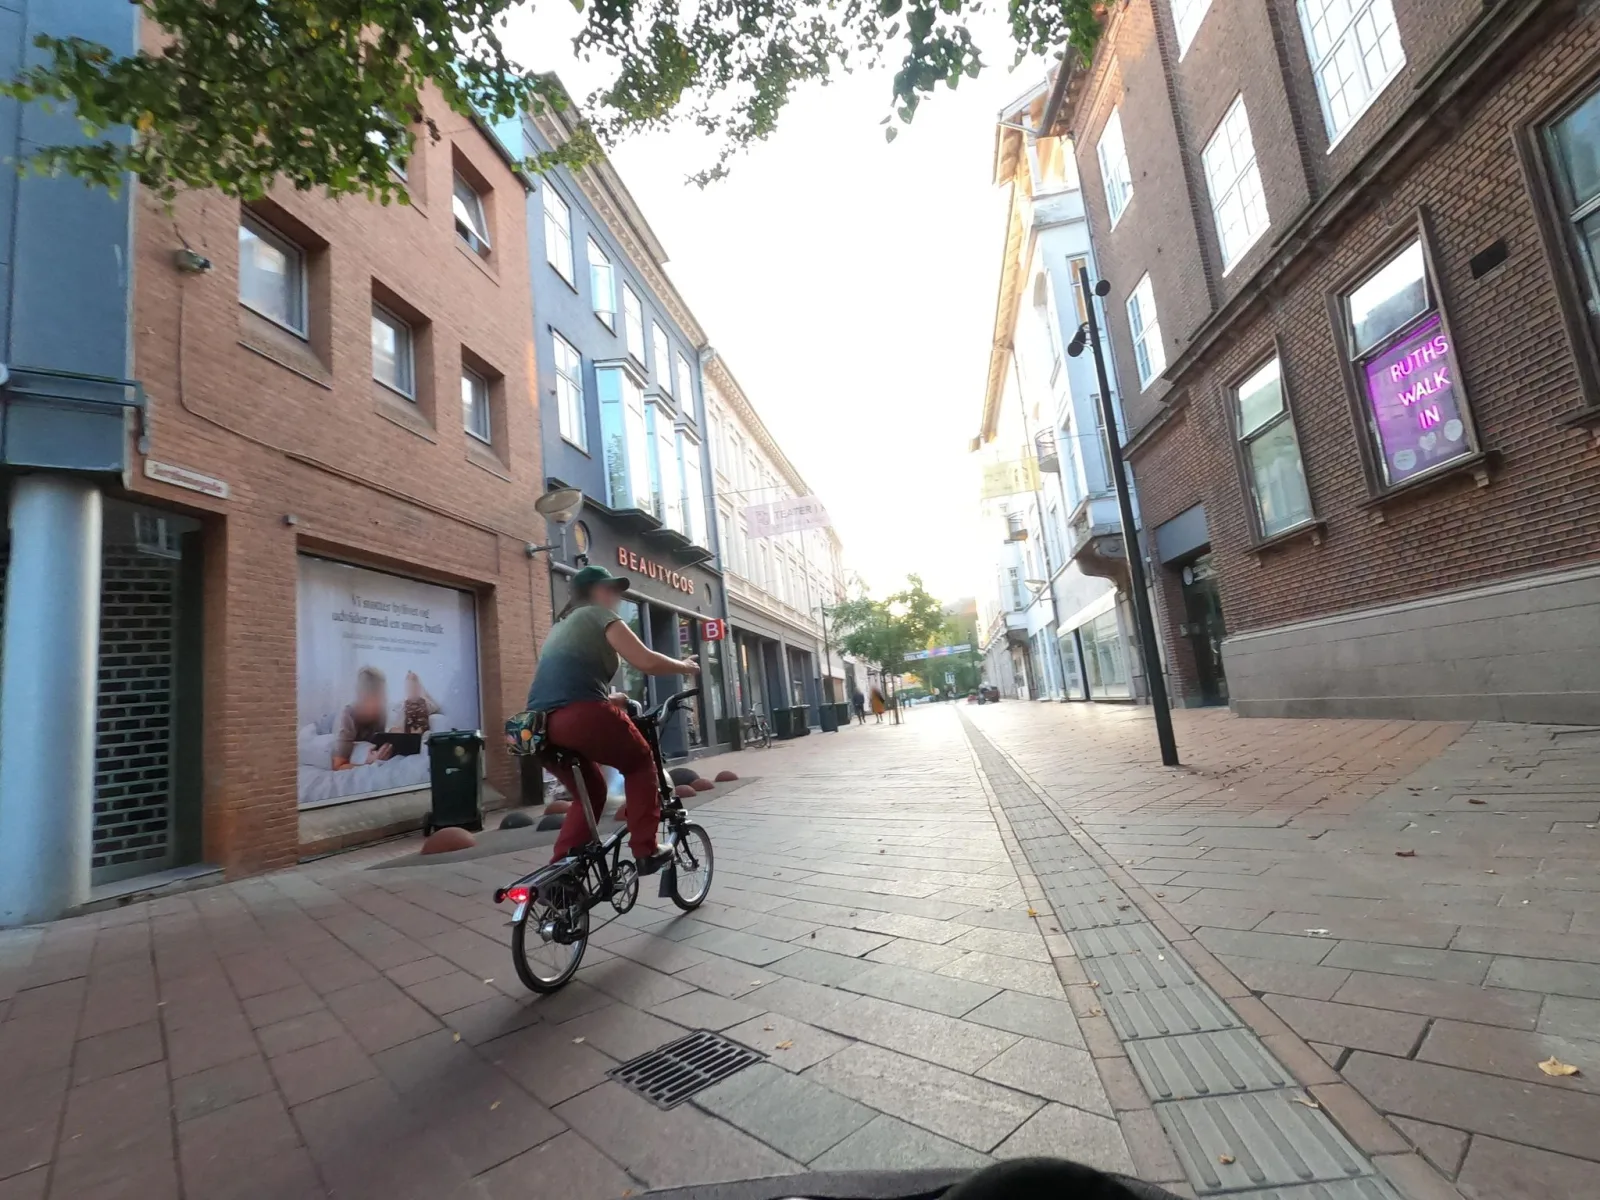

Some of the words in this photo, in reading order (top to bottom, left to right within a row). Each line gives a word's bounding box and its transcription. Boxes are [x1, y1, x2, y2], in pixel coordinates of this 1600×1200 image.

[1390, 335, 1449, 383] RUTHS
[1398, 367, 1451, 407] WALK
[1419, 405, 1440, 429] IN
[774, 504, 813, 520] TEATER
[618, 546, 695, 595] BEAUTYCOS
[706, 621, 719, 639] B
